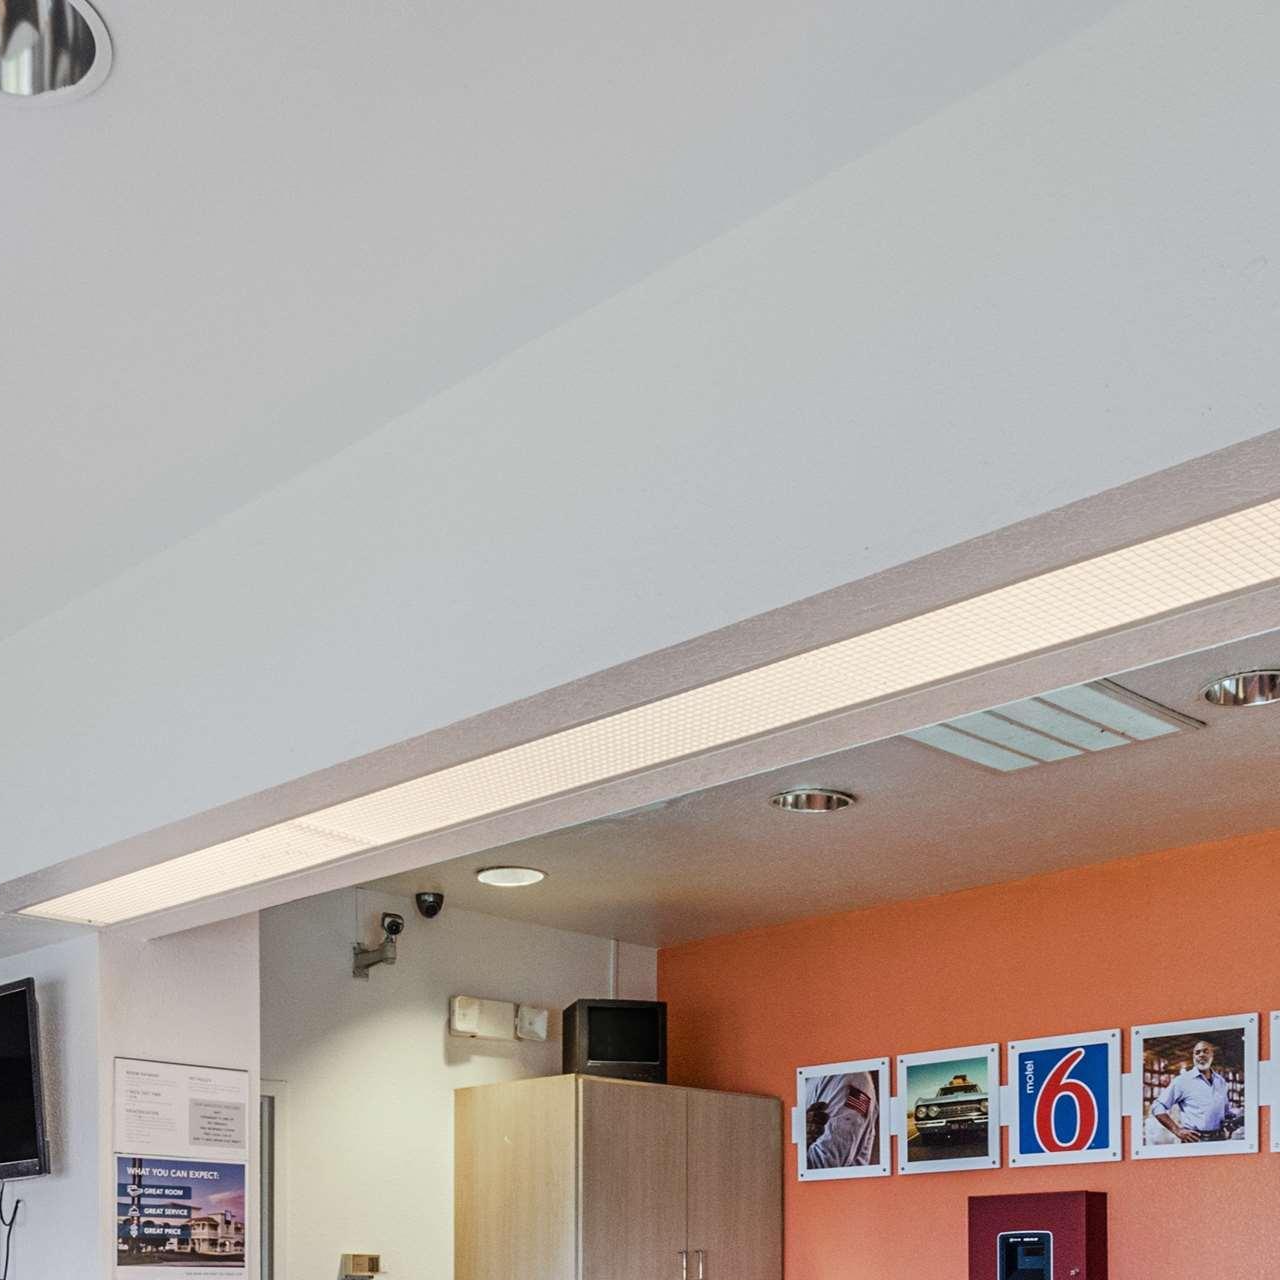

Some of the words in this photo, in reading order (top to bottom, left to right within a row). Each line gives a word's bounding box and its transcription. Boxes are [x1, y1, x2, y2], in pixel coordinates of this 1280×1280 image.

[1024, 1060, 1035, 1094] motel
[1033, 1047, 1098, 1153] 6
[126, 1167, 150, 1176] WHAT
[151, 1168, 169, 1177] YOU
[170, 1169, 188, 1178] CAN
[189, 1171, 220, 1180] EXPECT:
[143, 1207, 164, 1215] GREAT
[164, 1208, 188, 1216] SERVICE
[143, 1227, 164, 1235] GREAT
